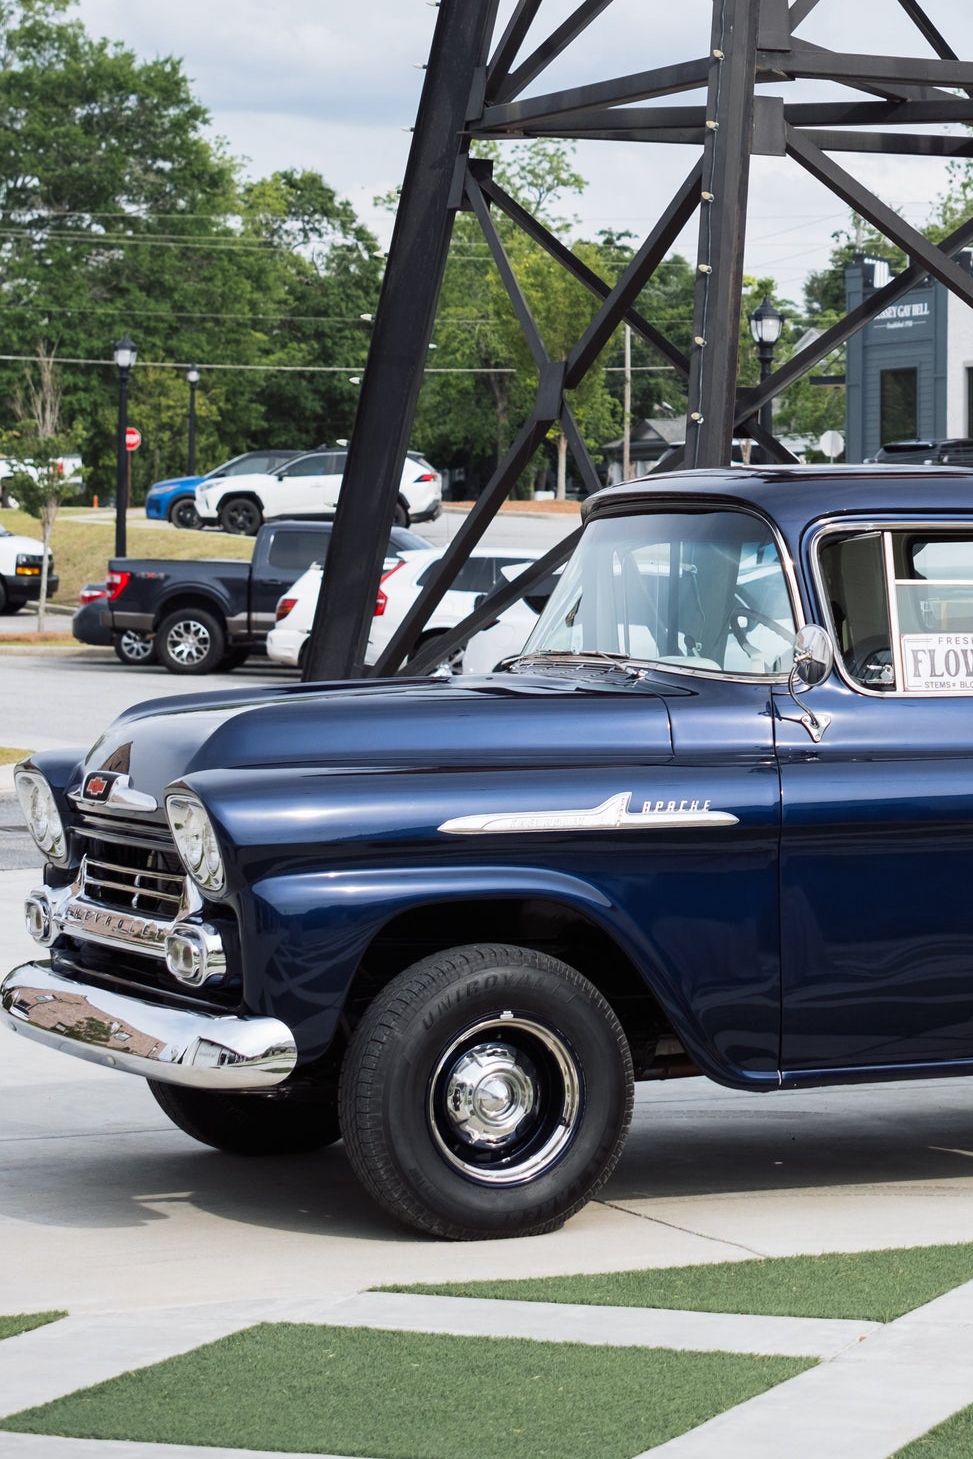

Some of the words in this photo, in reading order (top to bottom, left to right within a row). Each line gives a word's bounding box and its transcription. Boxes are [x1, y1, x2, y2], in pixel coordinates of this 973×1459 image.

[925, 681, 951, 689] STEMS
[641, 799, 711, 813] APACHE
[65, 907, 163, 938] CHEVROLET
